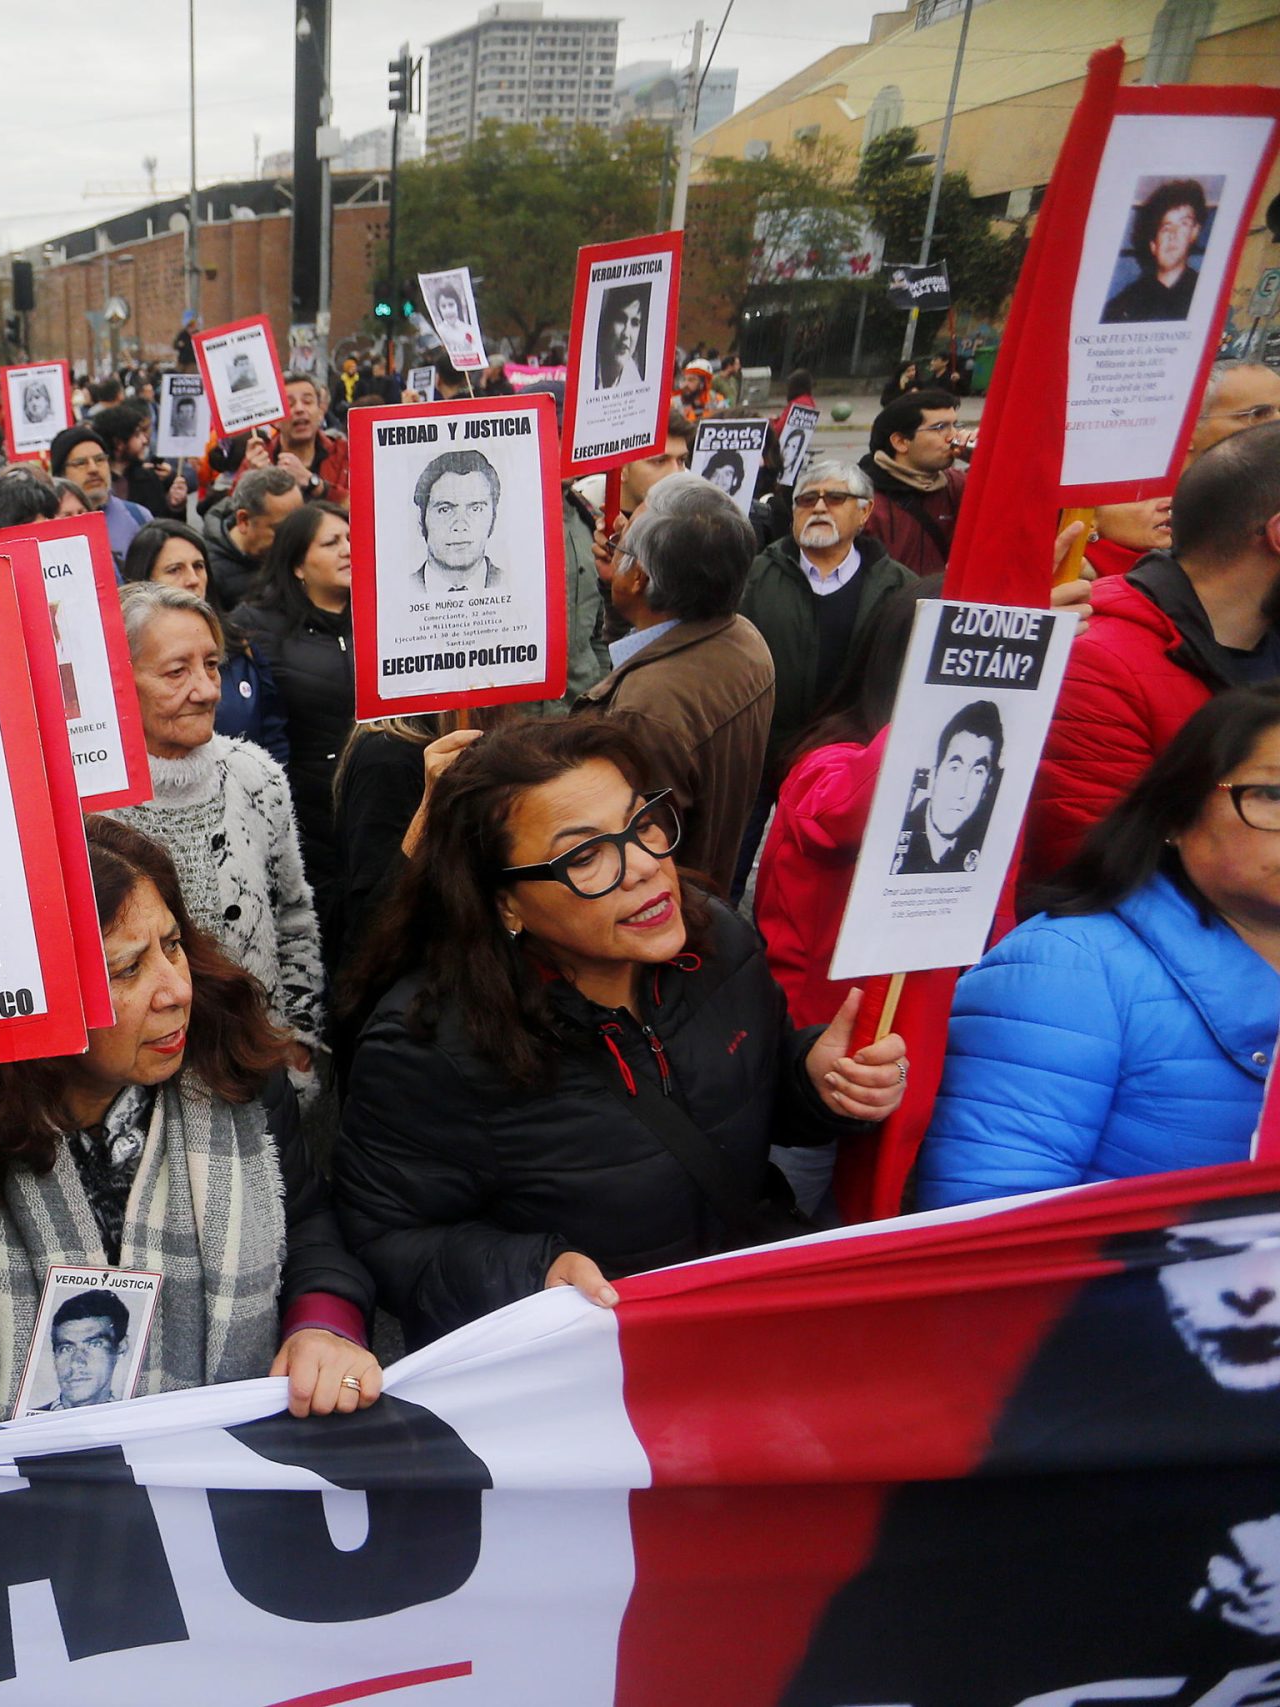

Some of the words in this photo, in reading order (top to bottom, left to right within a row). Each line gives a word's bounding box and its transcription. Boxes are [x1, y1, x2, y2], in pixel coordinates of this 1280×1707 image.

[592, 265, 622, 282] VERDAD
[623, 264, 630, 278] Y
[628, 259, 662, 276] JUSTICIA
[378, 424, 438, 446] VERDAD
[448, 422, 458, 440] Y
[464, 416, 532, 440] JUSTICIA
[703, 426, 762, 440] Dónde
[574, 440, 620, 460] EJECUTADA
[620, 432, 651, 450] POLÍTICA
[410, 603, 430, 612] JOSE
[436, 600, 464, 610] MUÑOZ
[468, 596, 512, 607] GONZALEZ
[382, 651, 466, 676] EJECUTADO
[469, 644, 538, 668] POLÍTICO
[940, 645, 1033, 681] ESTÁN?
[96, 722, 108, 730] DE
[56, 1274, 98, 1286] VERDAD
[109, 1279, 154, 1290] JUSTICIA
